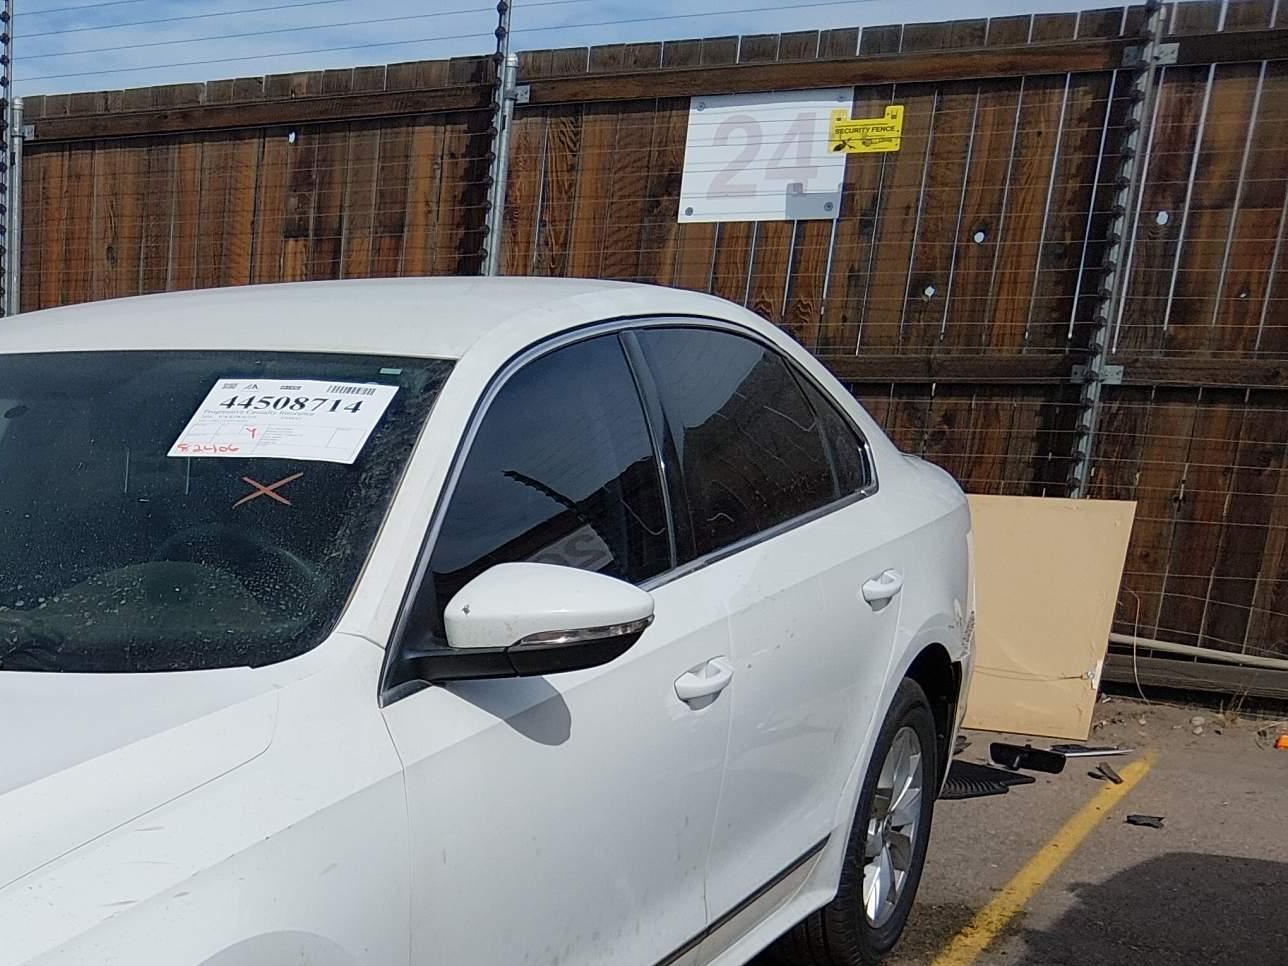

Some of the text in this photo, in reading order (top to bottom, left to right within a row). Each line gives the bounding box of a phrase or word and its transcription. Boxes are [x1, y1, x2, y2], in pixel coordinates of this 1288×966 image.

[834, 125, 896, 135] SECURITY FENCE
[706, 111, 817, 200] 24
[218, 394, 365, 414] 44508714
